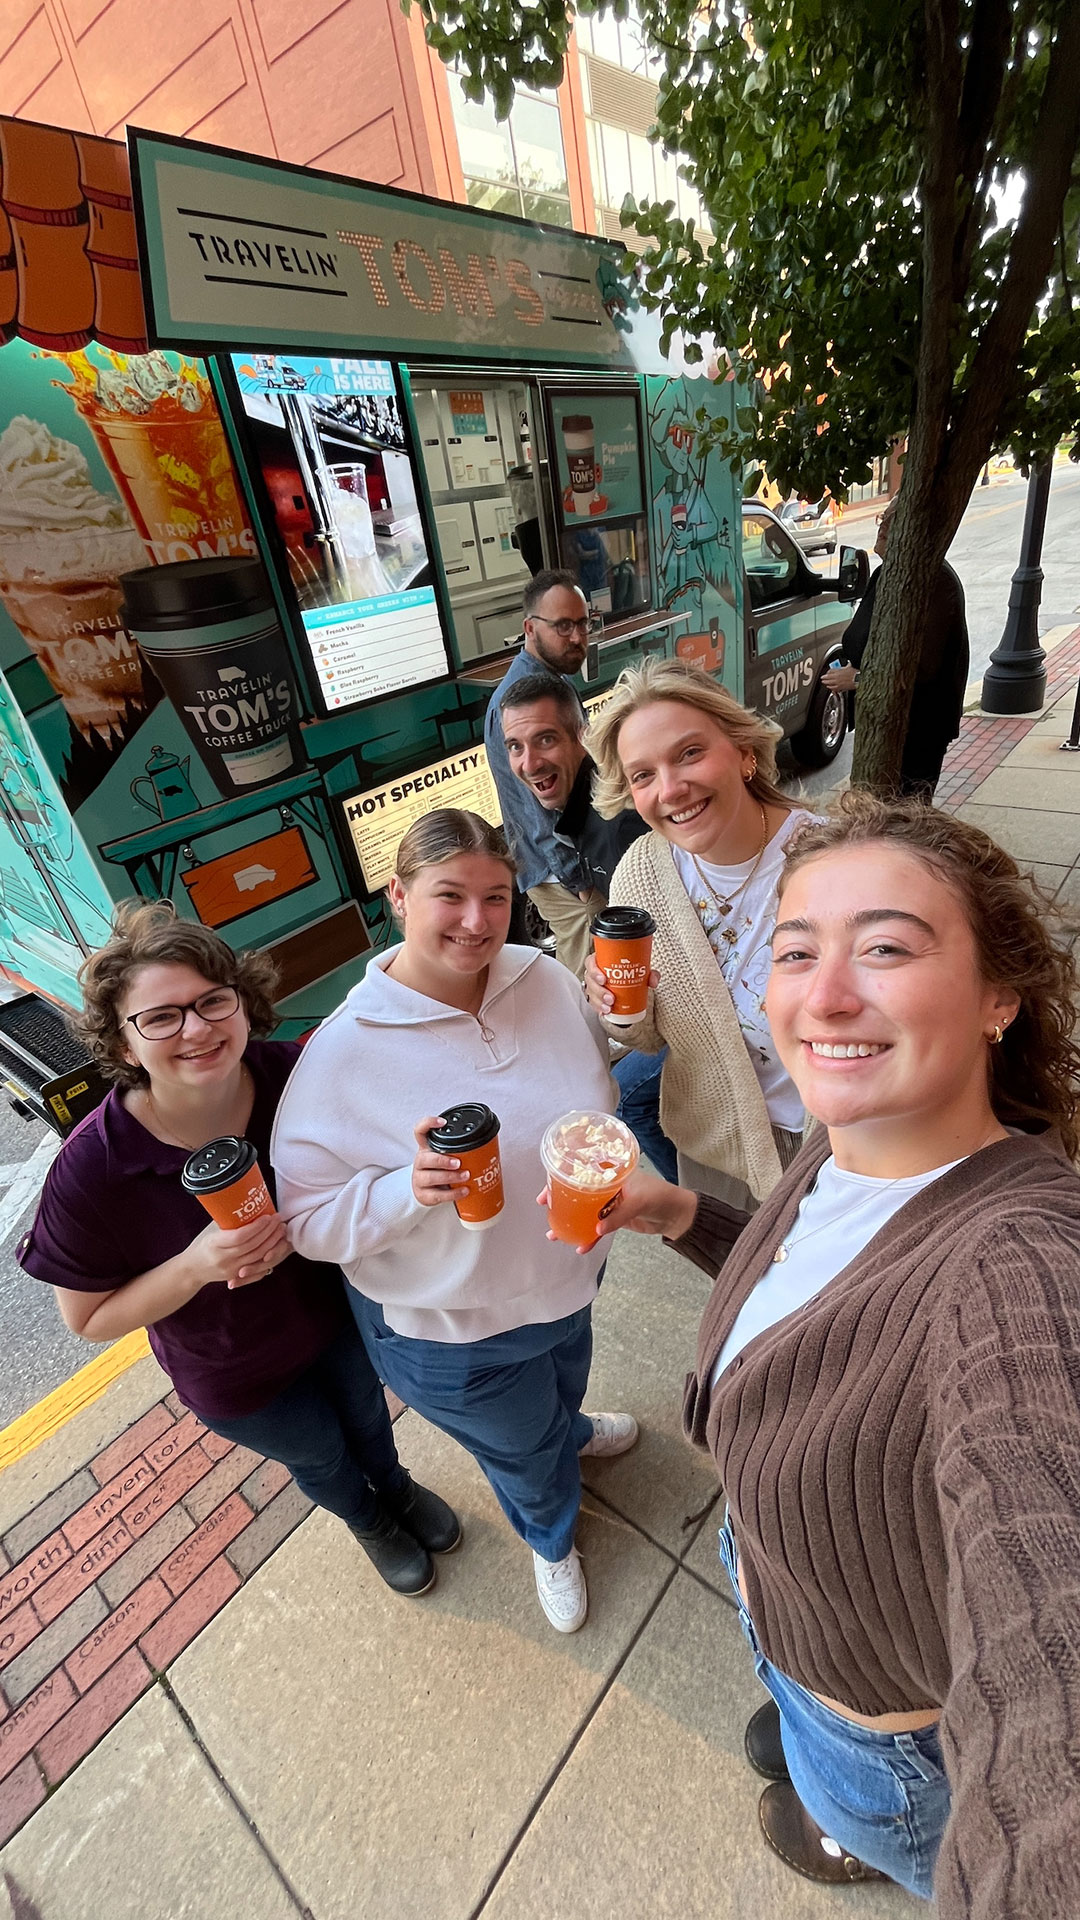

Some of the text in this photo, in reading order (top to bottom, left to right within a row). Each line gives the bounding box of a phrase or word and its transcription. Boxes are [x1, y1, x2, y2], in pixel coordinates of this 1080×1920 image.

[188, 231, 338, 278] TRAVELIN'
[336, 230, 544, 327] TOM'S
[334, 374, 393, 391] IS HERE
[601, 440, 637, 456] Pumpkin
[602, 454, 616, 467] Pie
[571, 469, 594, 484] TOM'S
[154, 516, 235, 538] TRAVELIN'
[325, 622, 365, 636] French Vanilla
[337, 664, 365, 676] Raspberry
[762, 656, 814, 707] TOM'S
[183, 680, 291, 734] TOM'S
[775, 694, 799, 714] COFFEE
[205, 713, 291, 747] COFFEE TRUCK
[347, 753, 479, 822] HOT SPECIALTY
[603, 965, 647, 980] TOM'S
[168, 1503, 234, 1573] comedian
